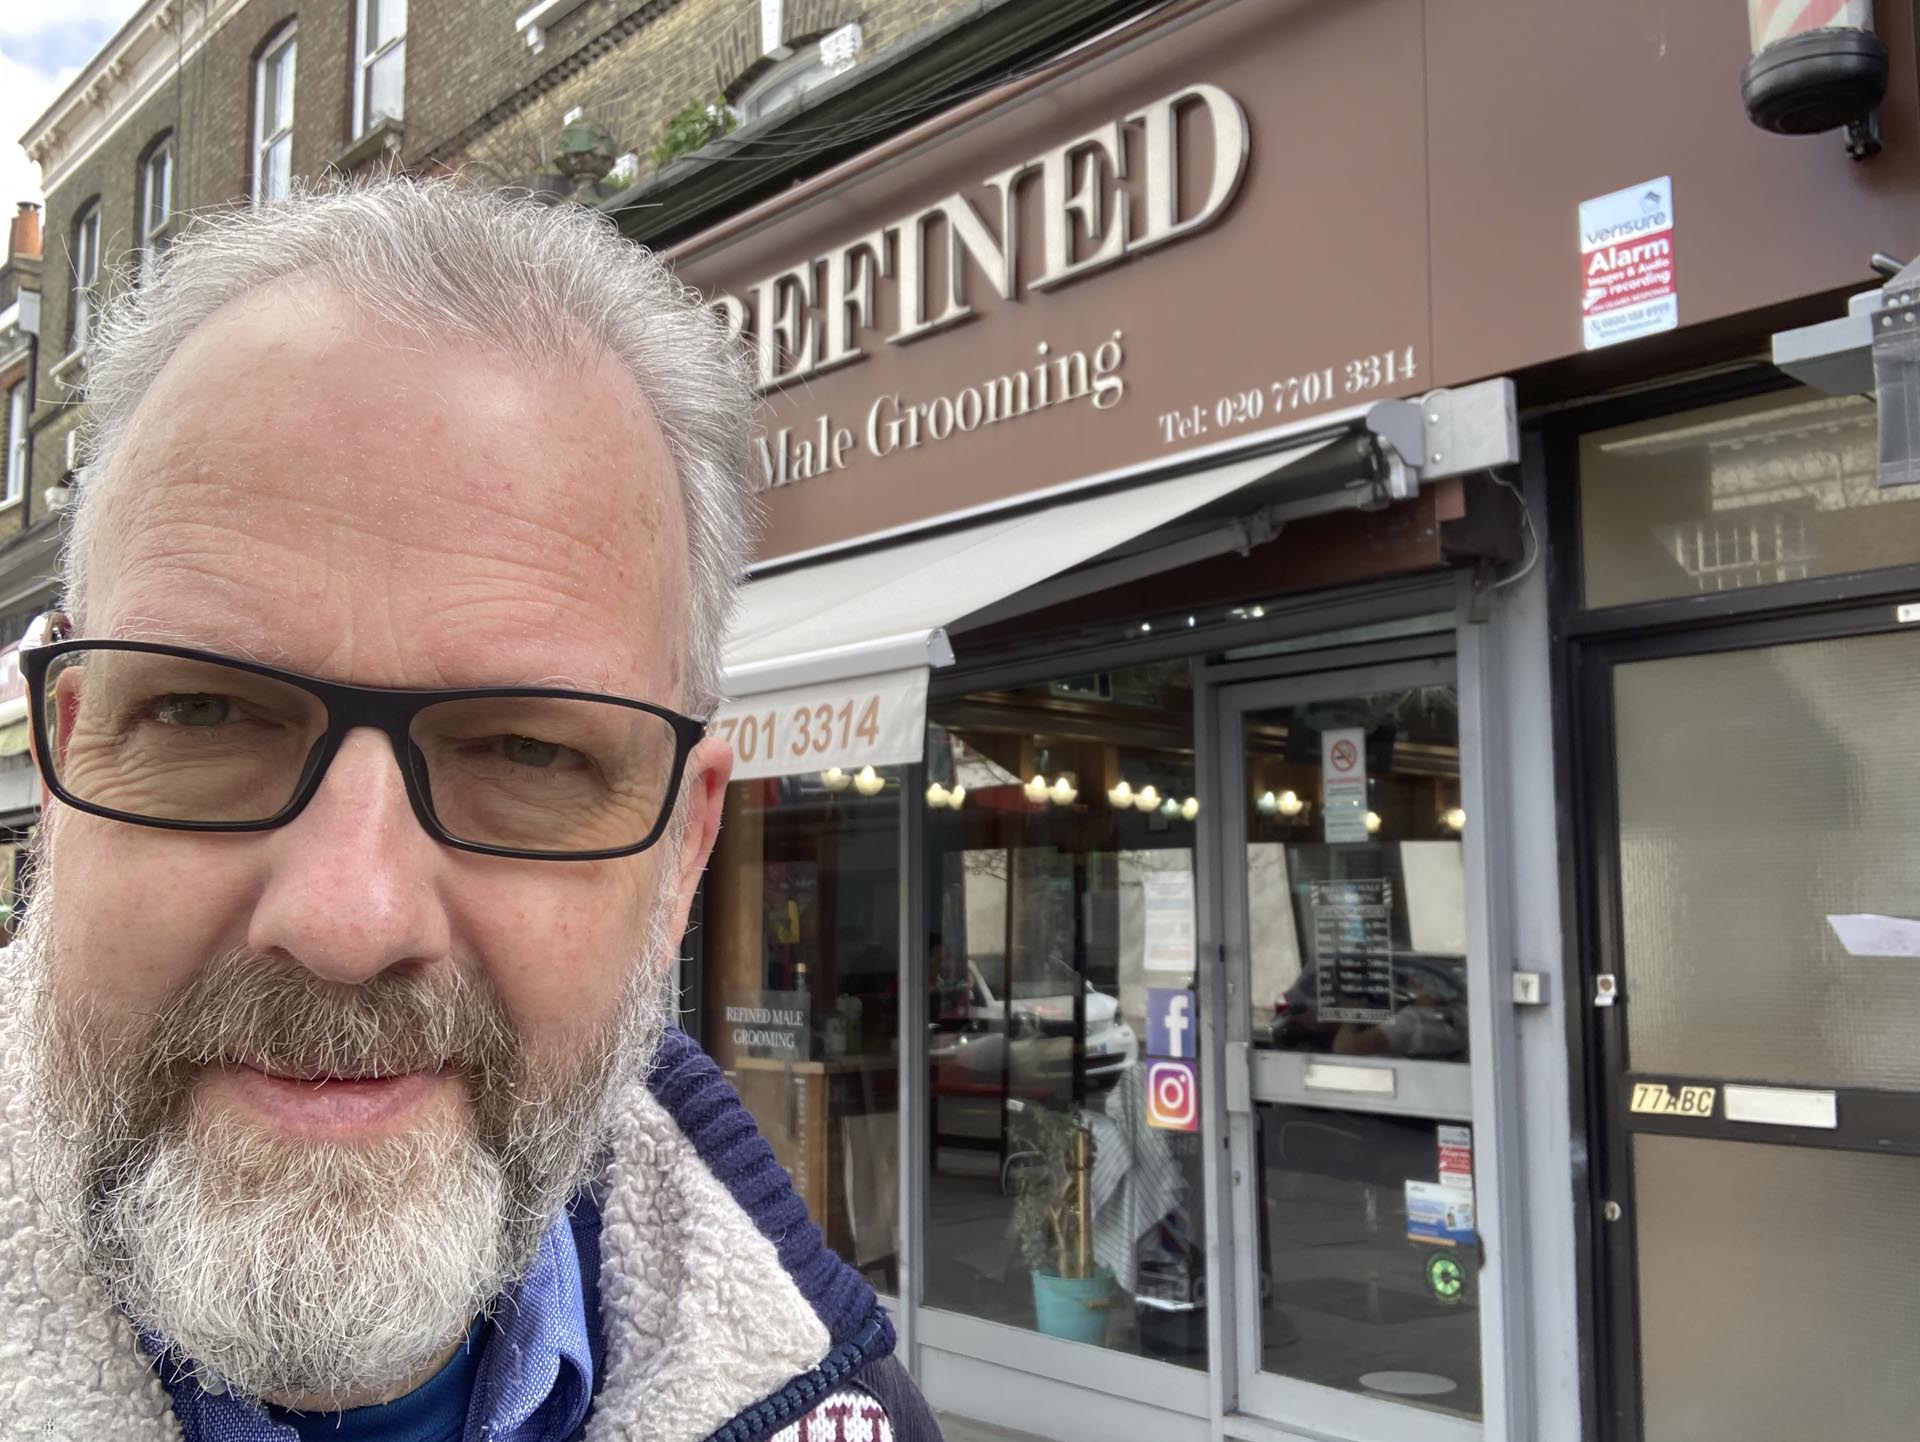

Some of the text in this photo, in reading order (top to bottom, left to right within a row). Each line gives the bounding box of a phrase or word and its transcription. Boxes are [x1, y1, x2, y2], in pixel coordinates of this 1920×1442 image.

[1588, 238, 1670, 276] Alarm
[753, 329, 1125, 492] Male Grooming
[1158, 345, 1417, 444] Tel: 020 7701 3314
[711, 694, 881, 763] 701 3314
[726, 1006, 804, 1026] REFINED MALE
[733, 1028, 796, 1050] GROOMING
